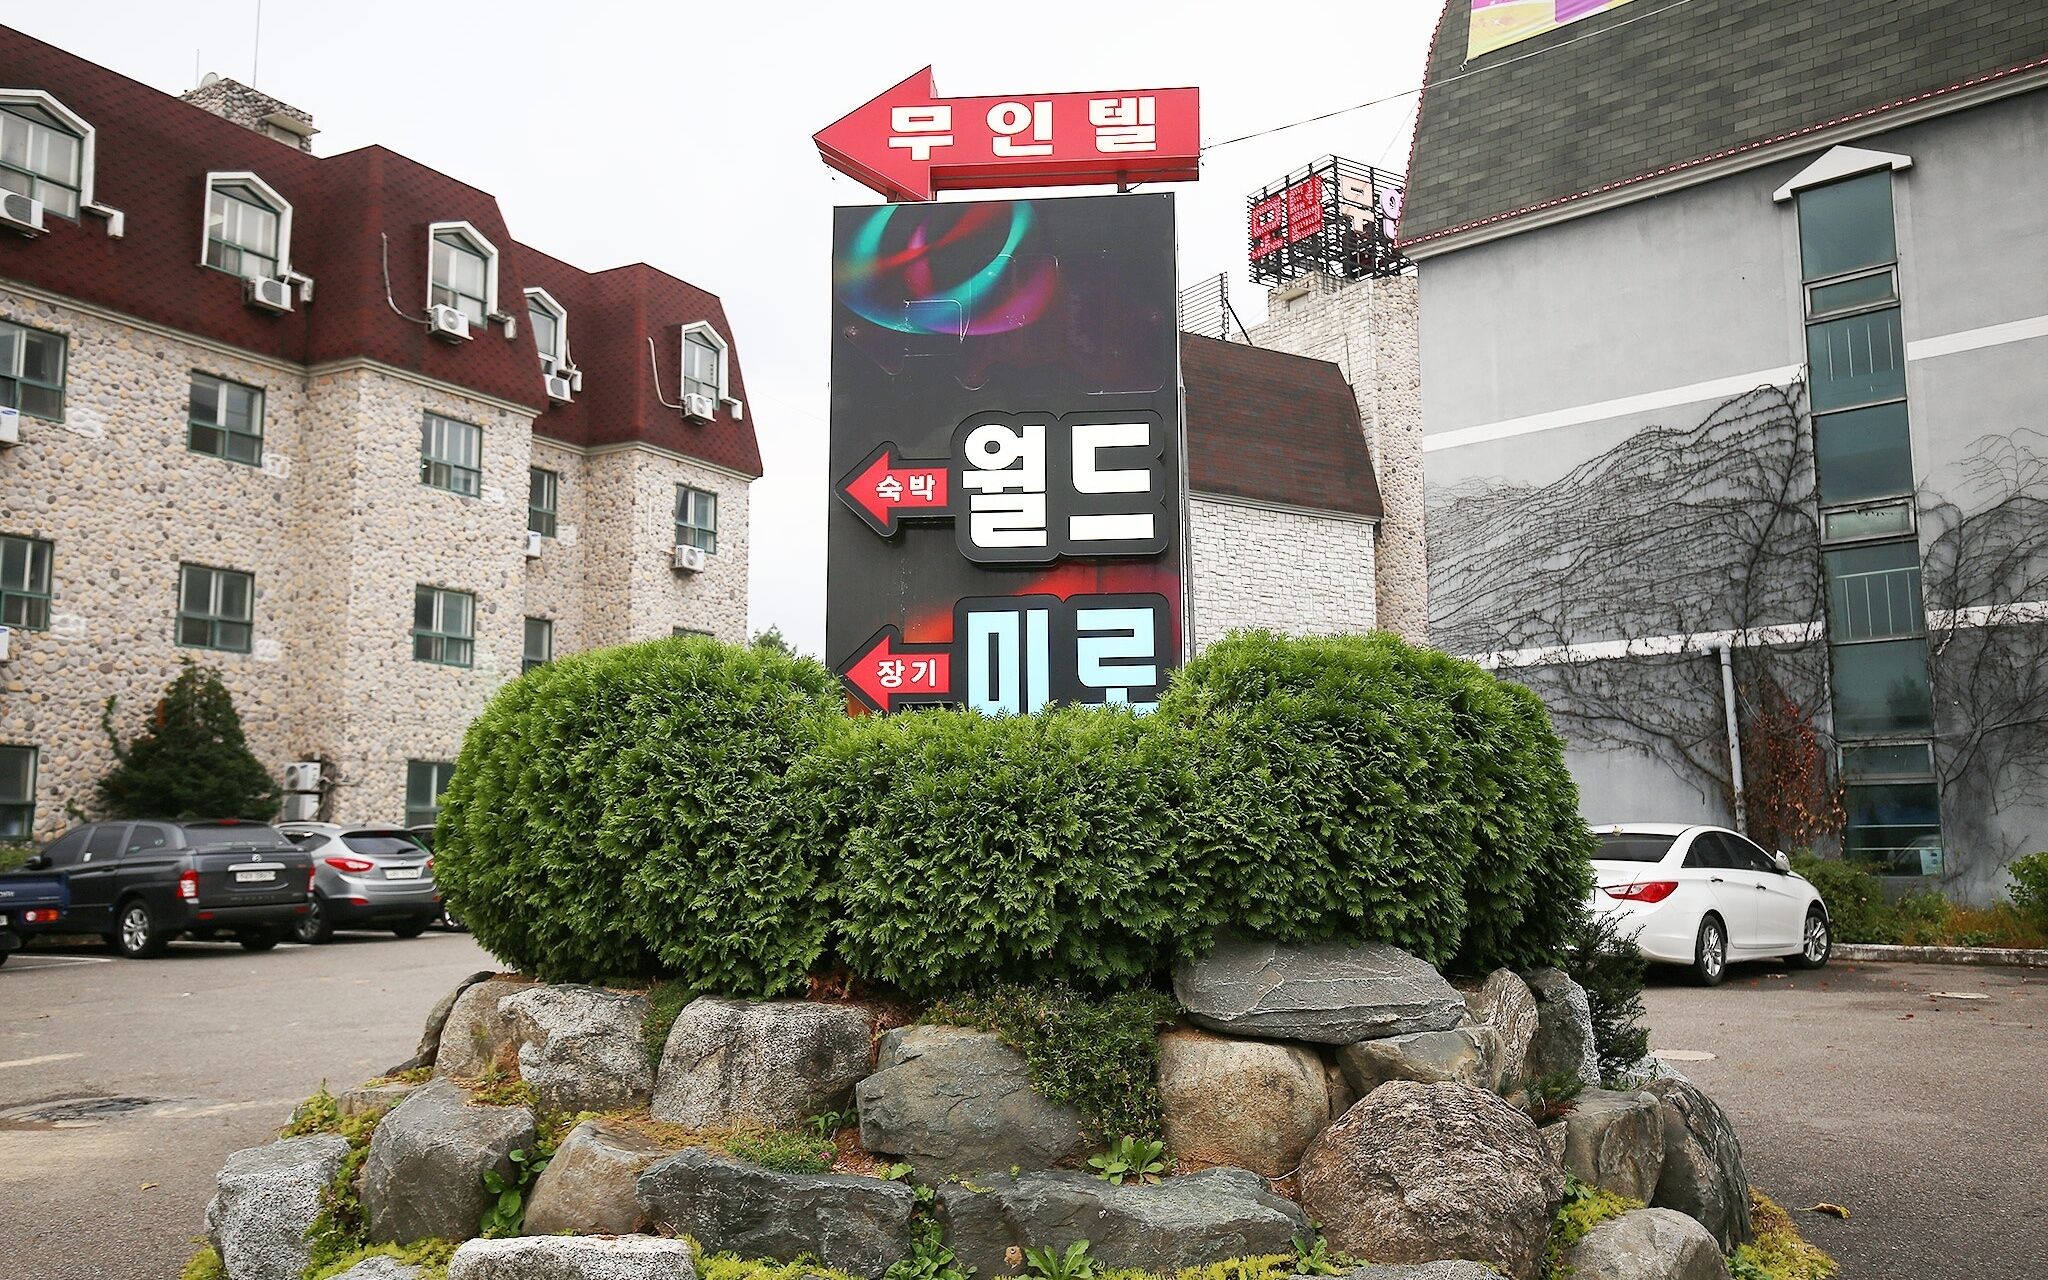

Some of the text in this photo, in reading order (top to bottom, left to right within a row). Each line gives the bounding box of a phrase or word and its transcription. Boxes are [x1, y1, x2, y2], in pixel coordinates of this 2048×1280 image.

[888, 95, 1158, 161] 무인텔
[1249, 174, 1324, 261] 모텔
[875, 474, 936, 502] 숙박
[962, 422, 1156, 548] 월드
[876, 658, 937, 688] 장기
[967, 607, 1160, 716] 미로
